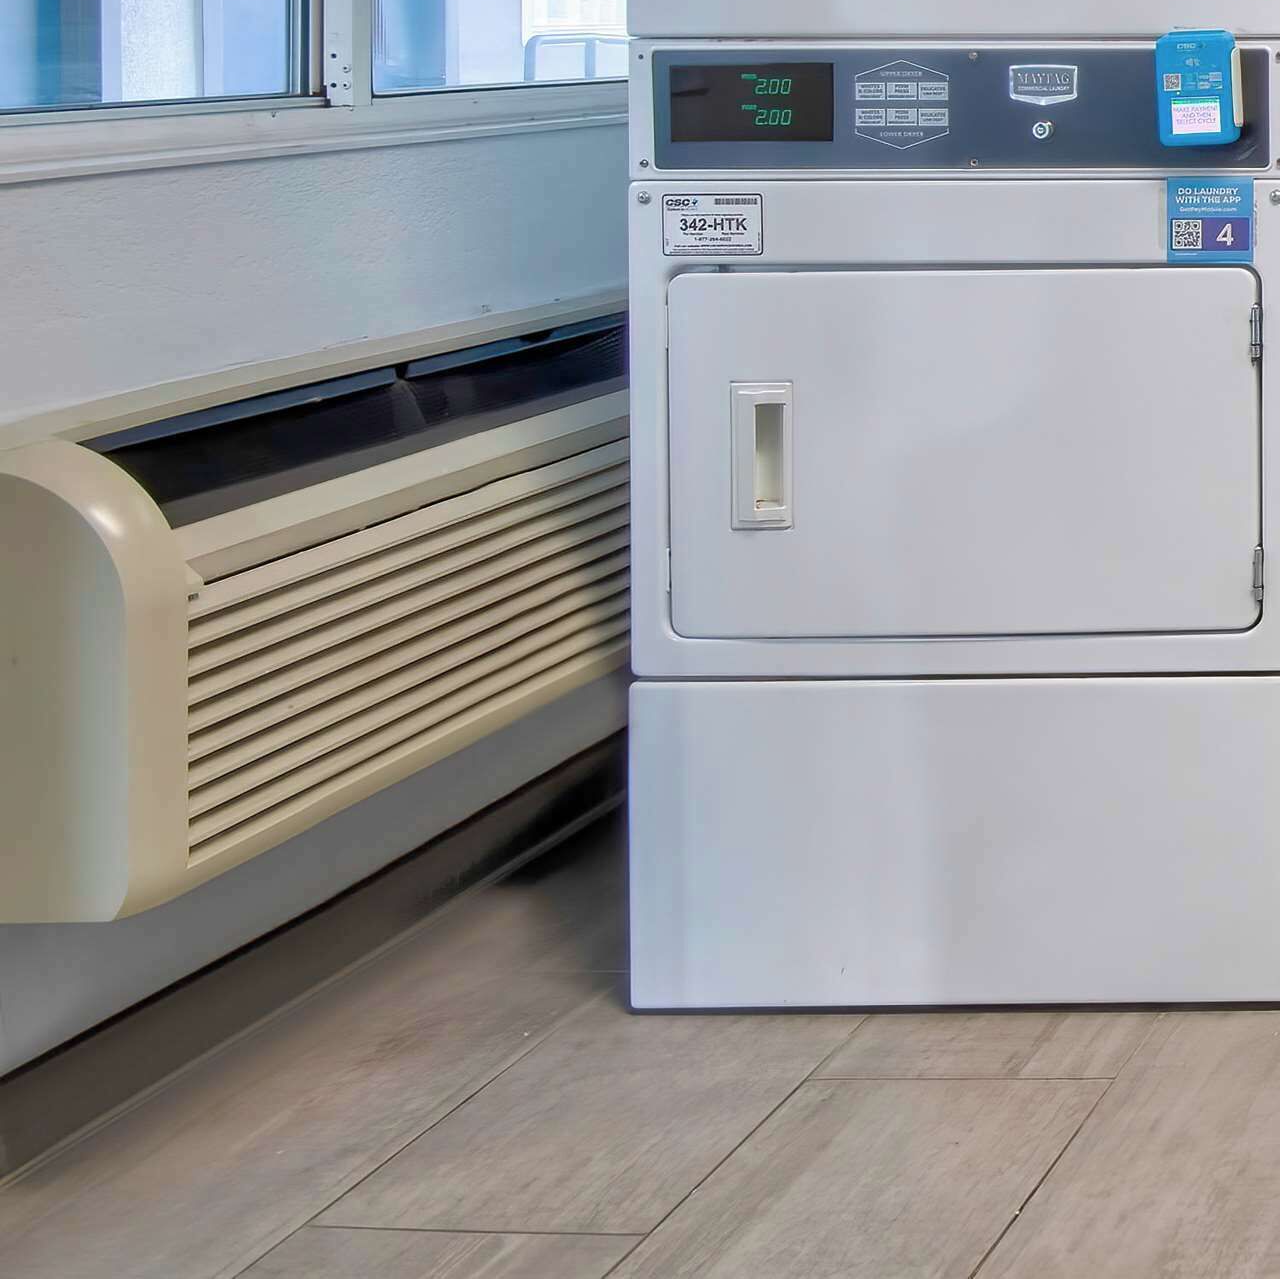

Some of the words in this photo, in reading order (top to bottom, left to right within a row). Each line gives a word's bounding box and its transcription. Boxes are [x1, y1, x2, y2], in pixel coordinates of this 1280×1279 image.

[756, 79, 791, 94] 2.00
[756, 110, 791, 125] 2.00
[680, 218, 747, 231] 342-HTK
[1216, 223, 1234, 245] 4
